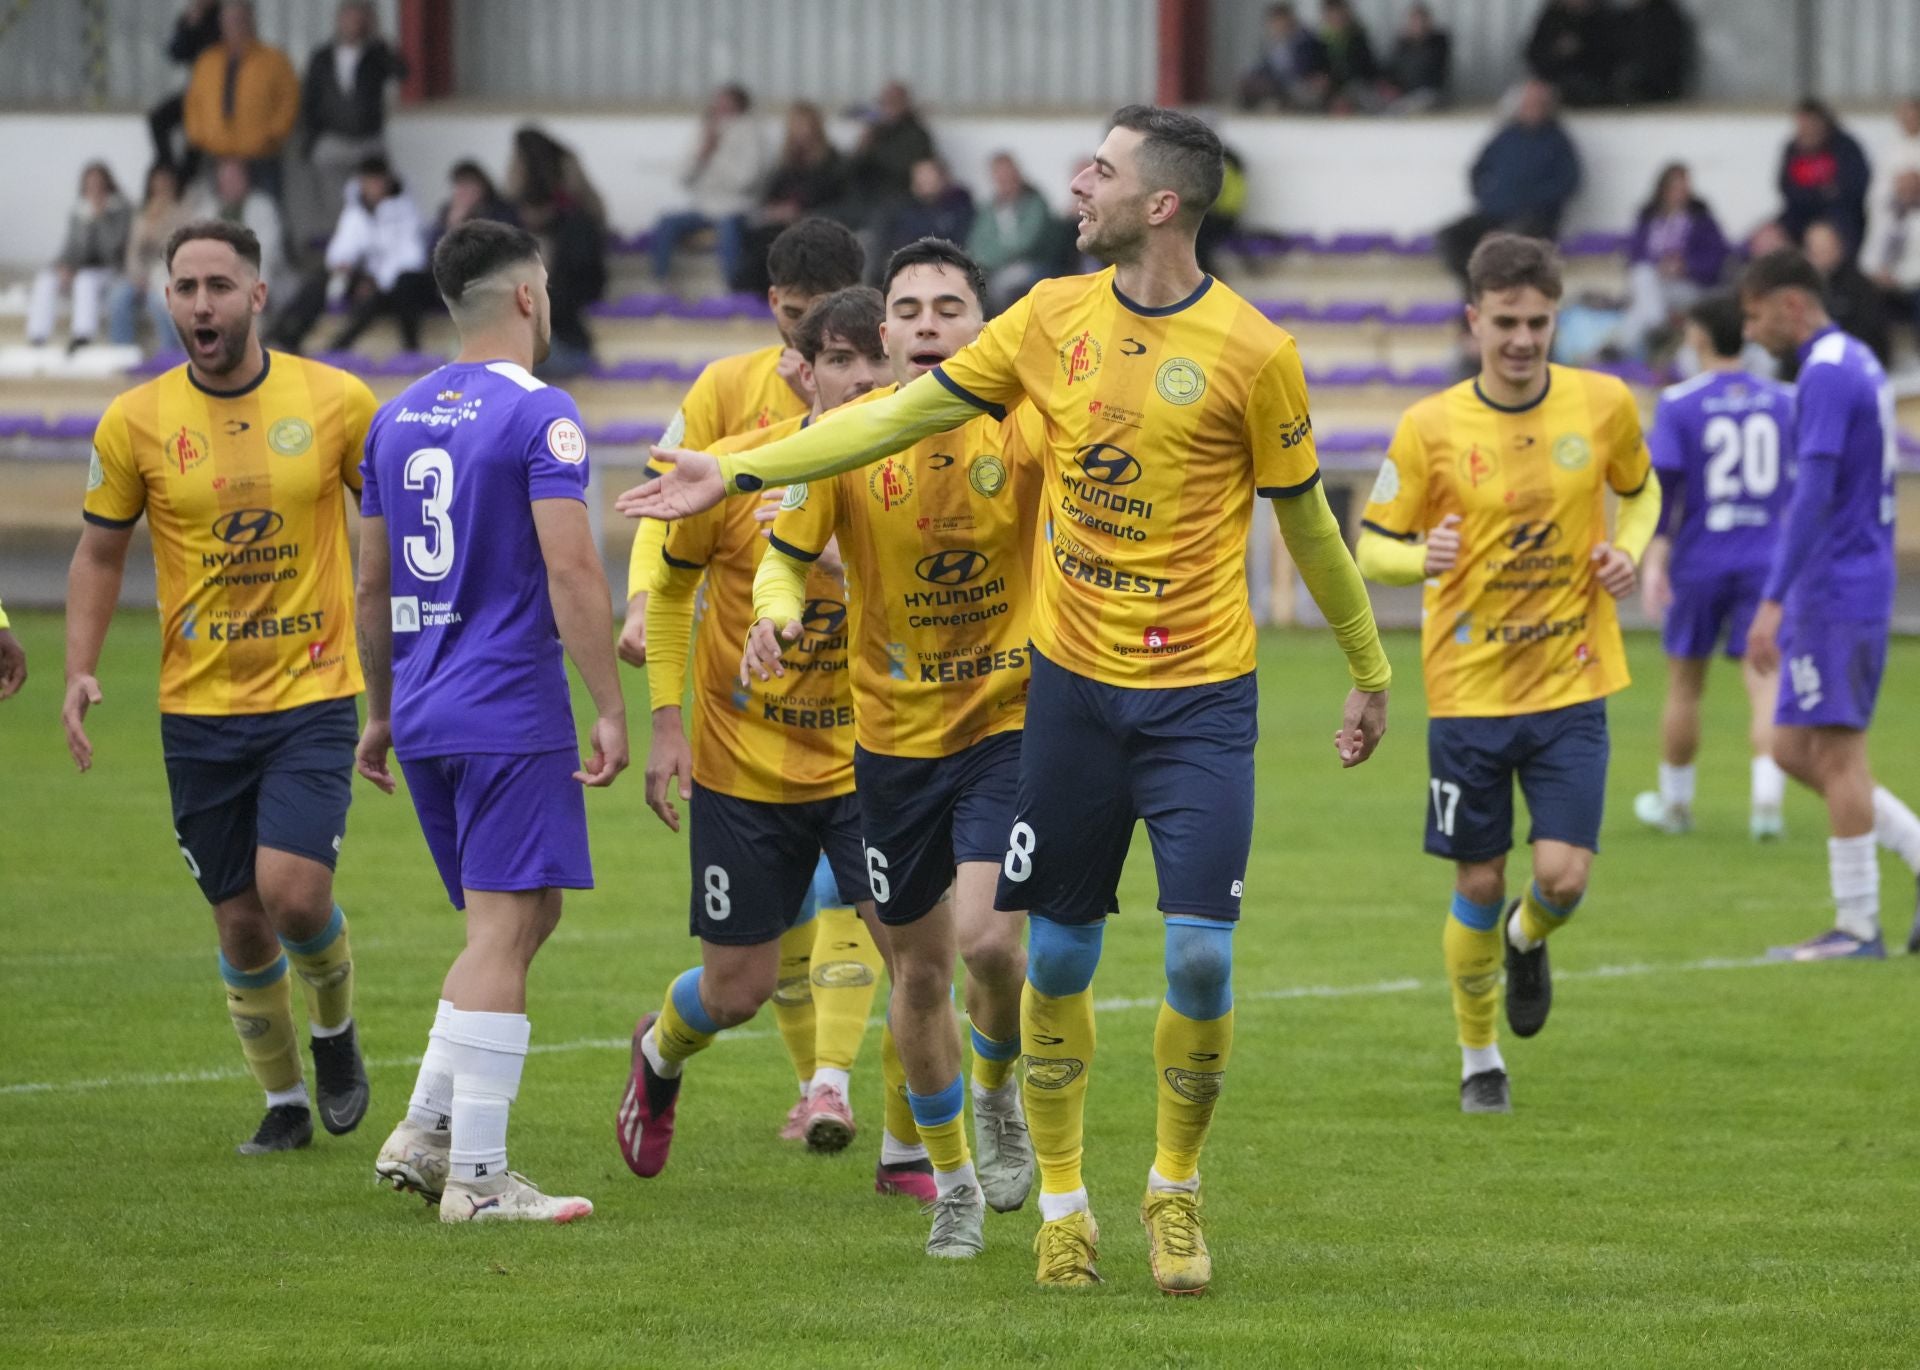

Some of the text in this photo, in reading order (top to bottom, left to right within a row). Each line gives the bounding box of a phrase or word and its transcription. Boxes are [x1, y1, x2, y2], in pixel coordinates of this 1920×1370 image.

[1704, 412, 1779, 502] 20
[1061, 471, 1152, 519] HYUNDAI
[404, 448, 455, 582] 3
[1061, 496, 1147, 542] Cerverauto
[202, 544, 298, 568] HYUNDAI
[1056, 532, 1114, 567] FUNDACIÓN
[1055, 545, 1171, 598] KERBEST
[904, 577, 1006, 608] HYUNDAI
[209, 611, 324, 642] KERBEST
[909, 602, 1009, 628] Cerverauto
[917, 643, 992, 661] FUNDACIÓN
[1112, 643, 1149, 656] ágora
[763, 691, 837, 706] FUNDACIÓN
[763, 701, 856, 729] KERBE
[1430, 778, 1461, 836] 17
[704, 865, 731, 920] 8
